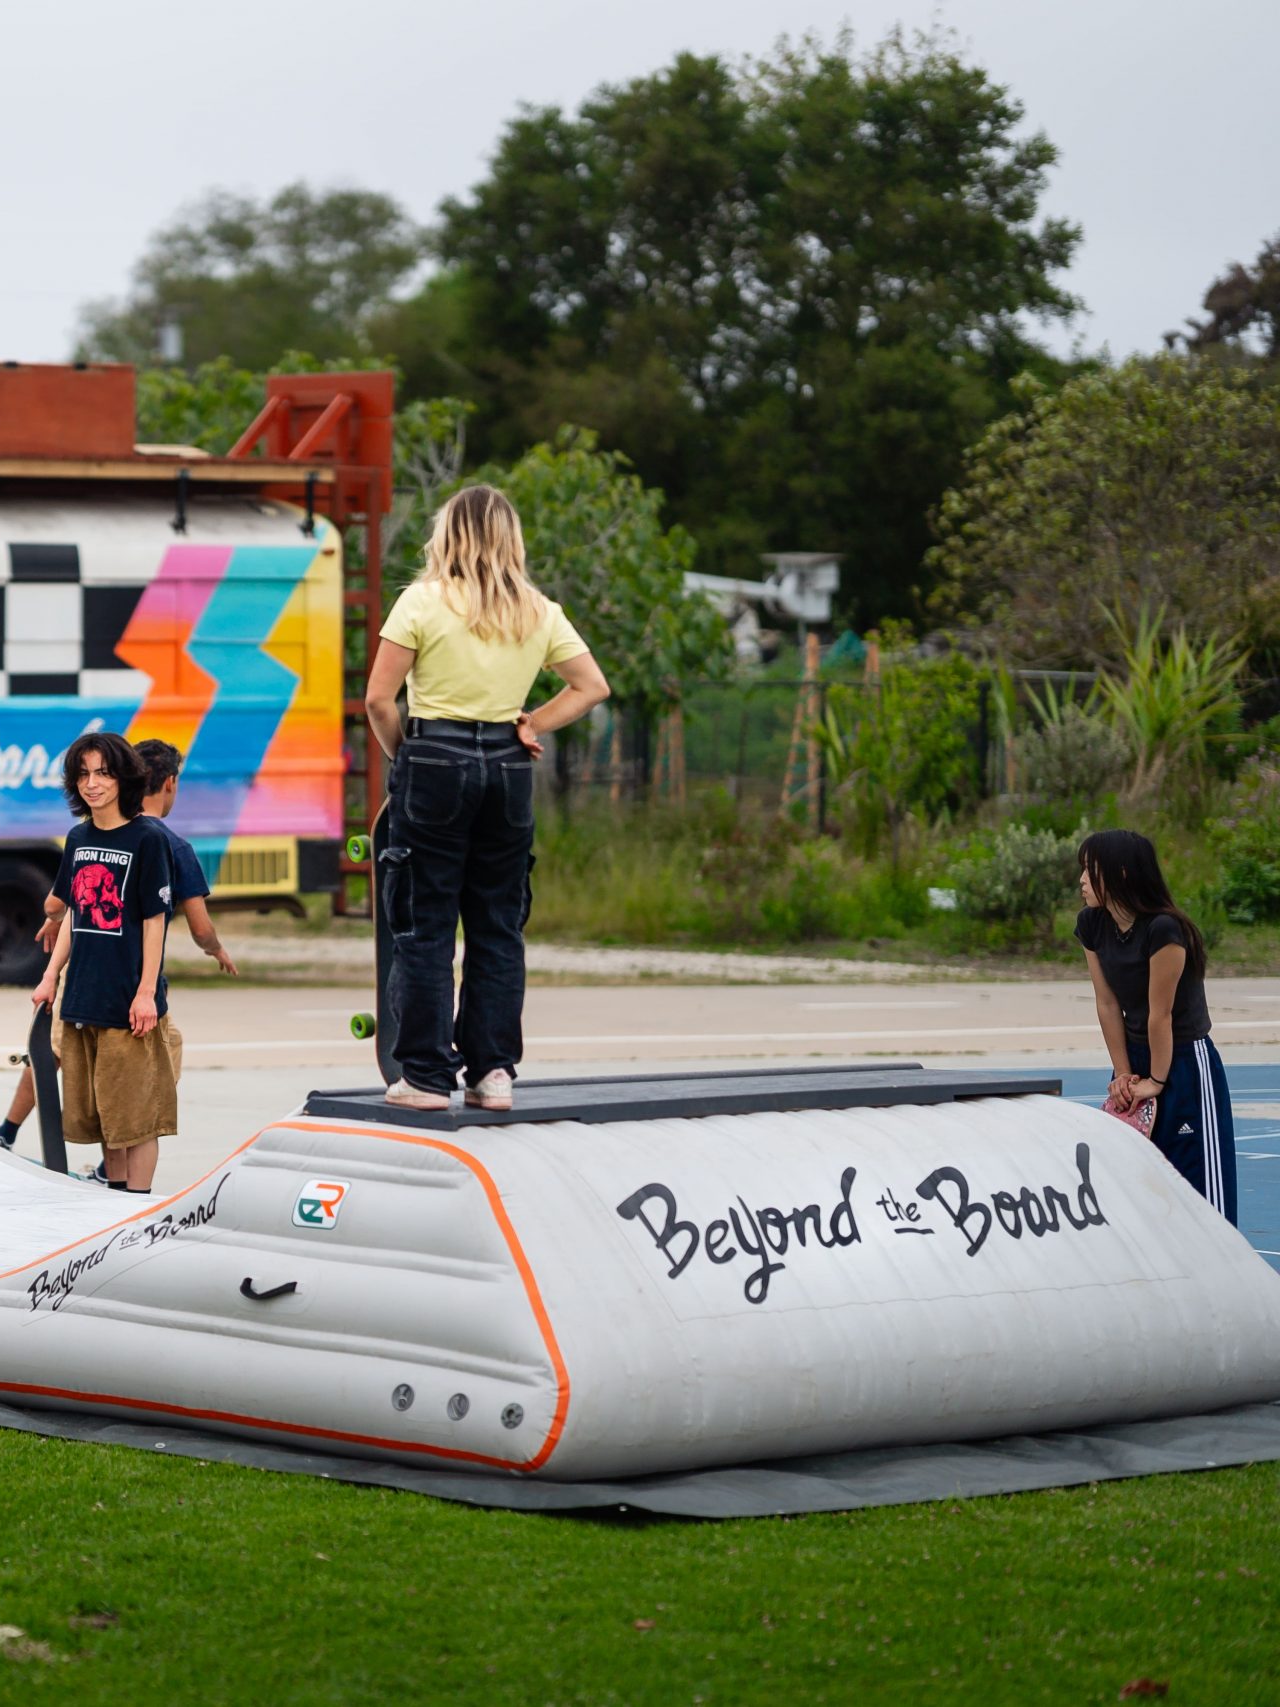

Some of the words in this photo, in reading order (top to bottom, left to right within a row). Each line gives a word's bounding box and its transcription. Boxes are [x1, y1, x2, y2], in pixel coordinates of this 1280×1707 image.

[74, 850, 98, 862] IRON
[99, 852, 128, 866] LUNG
[26, 1228, 126, 1313] Beyond
[143, 1171, 232, 1249] Board
[616, 1166, 862, 1304] Beyond
[876, 1187, 923, 1223] the
[915, 1142, 1110, 1258] Board
